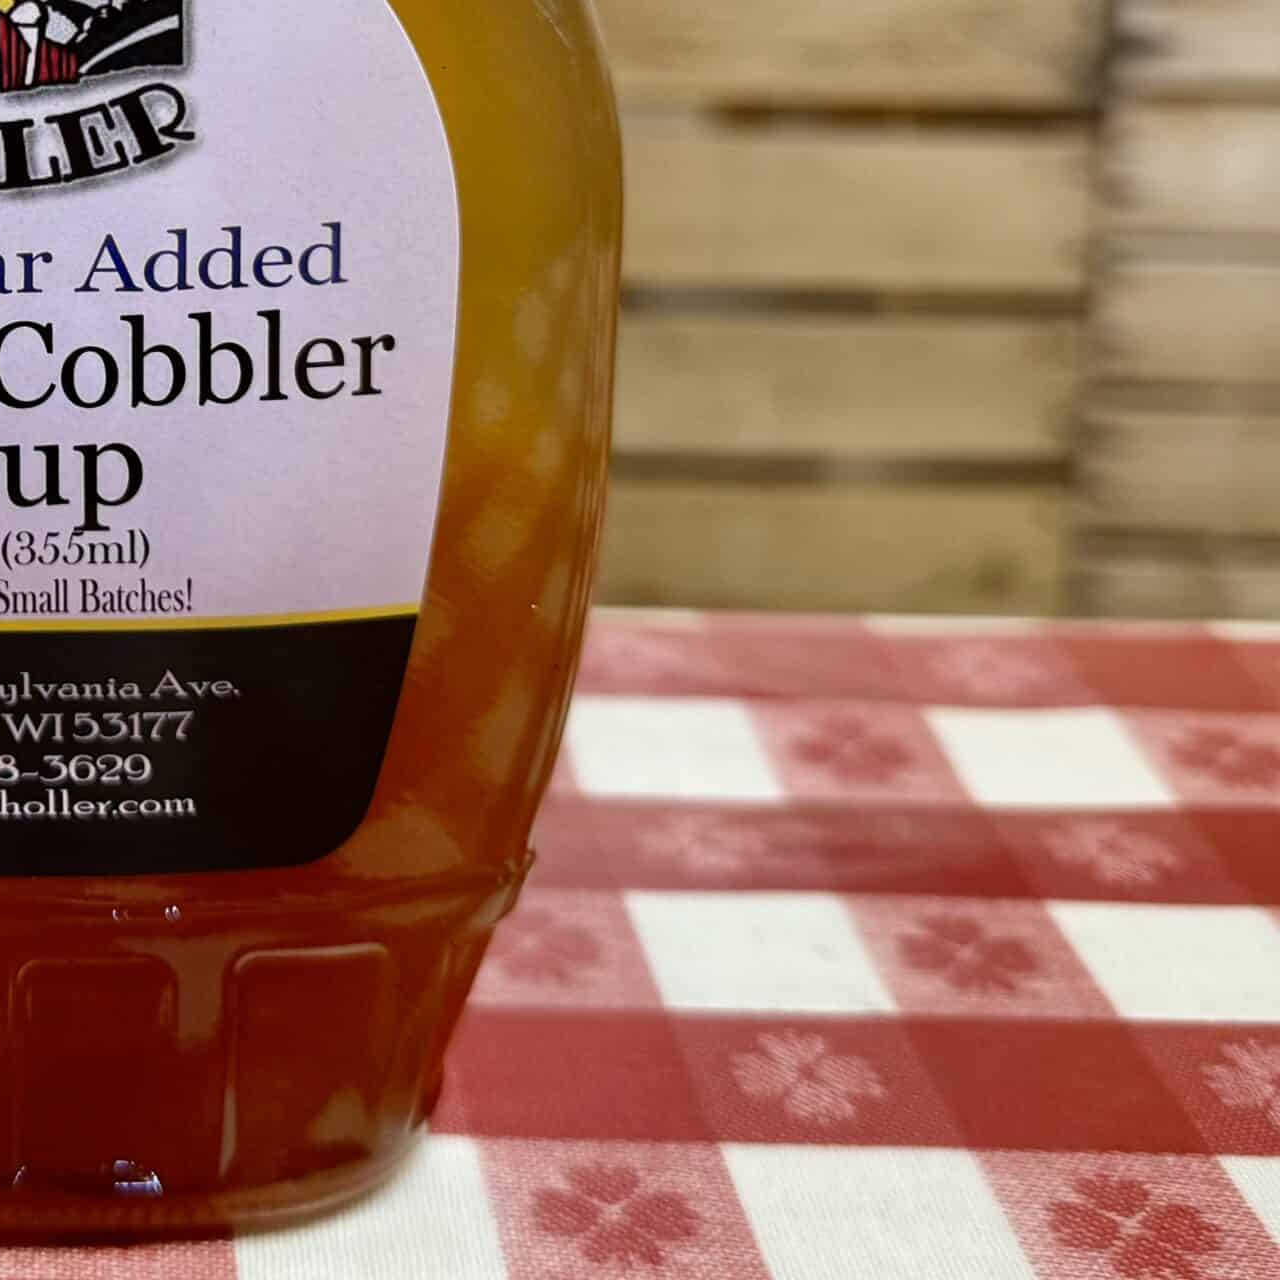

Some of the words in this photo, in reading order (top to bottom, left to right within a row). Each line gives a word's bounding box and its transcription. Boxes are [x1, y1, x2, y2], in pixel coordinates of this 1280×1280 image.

[74, 221, 348, 293] Added
[1, 527, 150, 571] (355ml)
[79, 577, 193, 614] Batches!
[150, 669, 239, 698] Ave.
[1, 713, 63, 741] WI
[72, 710, 193, 740] 53177
